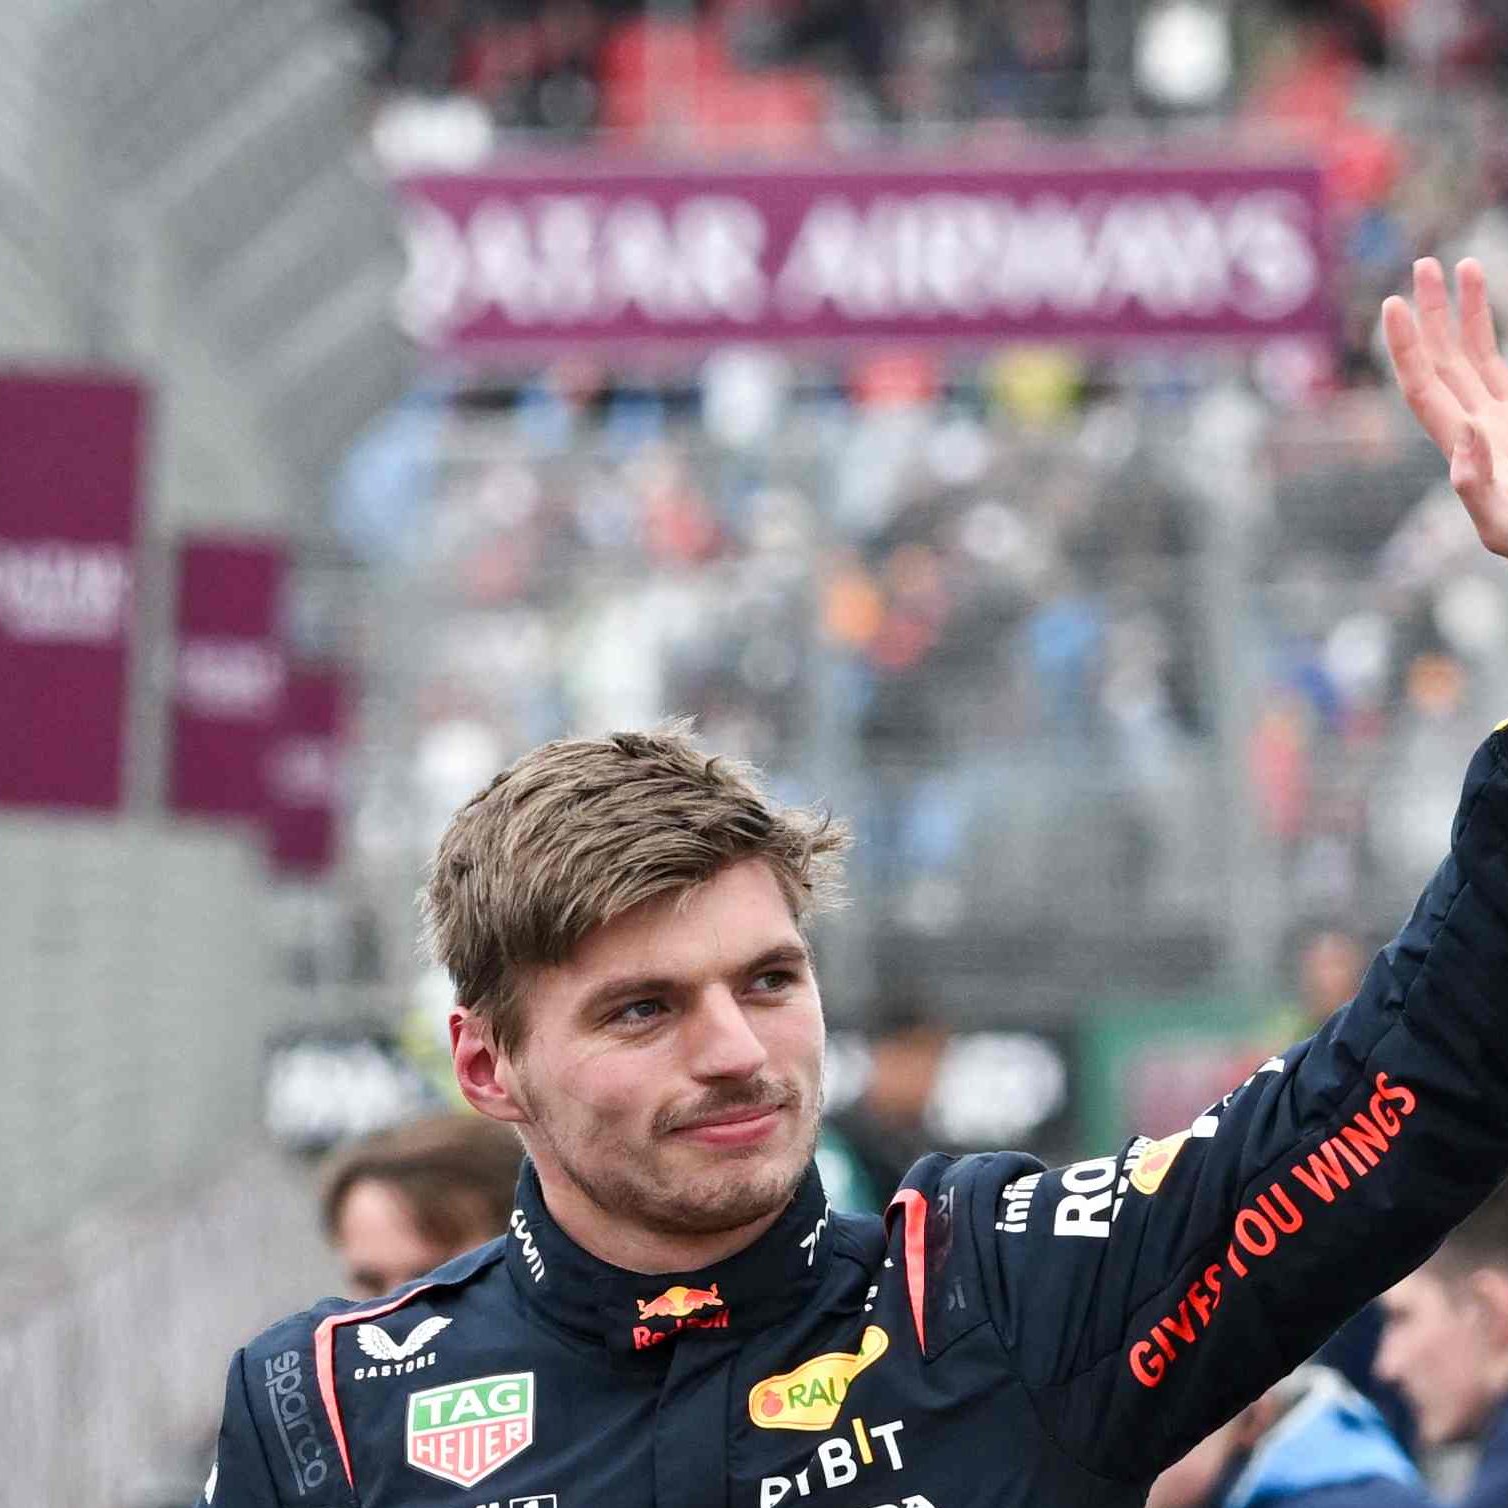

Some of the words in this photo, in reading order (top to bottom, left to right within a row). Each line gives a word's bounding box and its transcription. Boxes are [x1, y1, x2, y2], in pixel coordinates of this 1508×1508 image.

[775, 190, 1320, 322] AIRWAYS
[1291, 1071, 1417, 1203] WINGS
[354, 1351, 437, 1381] CASTORE
[420, 1381, 522, 1425] TAG
[264, 1350, 328, 1496] sparco
[416, 1424, 526, 1475] HEUER
